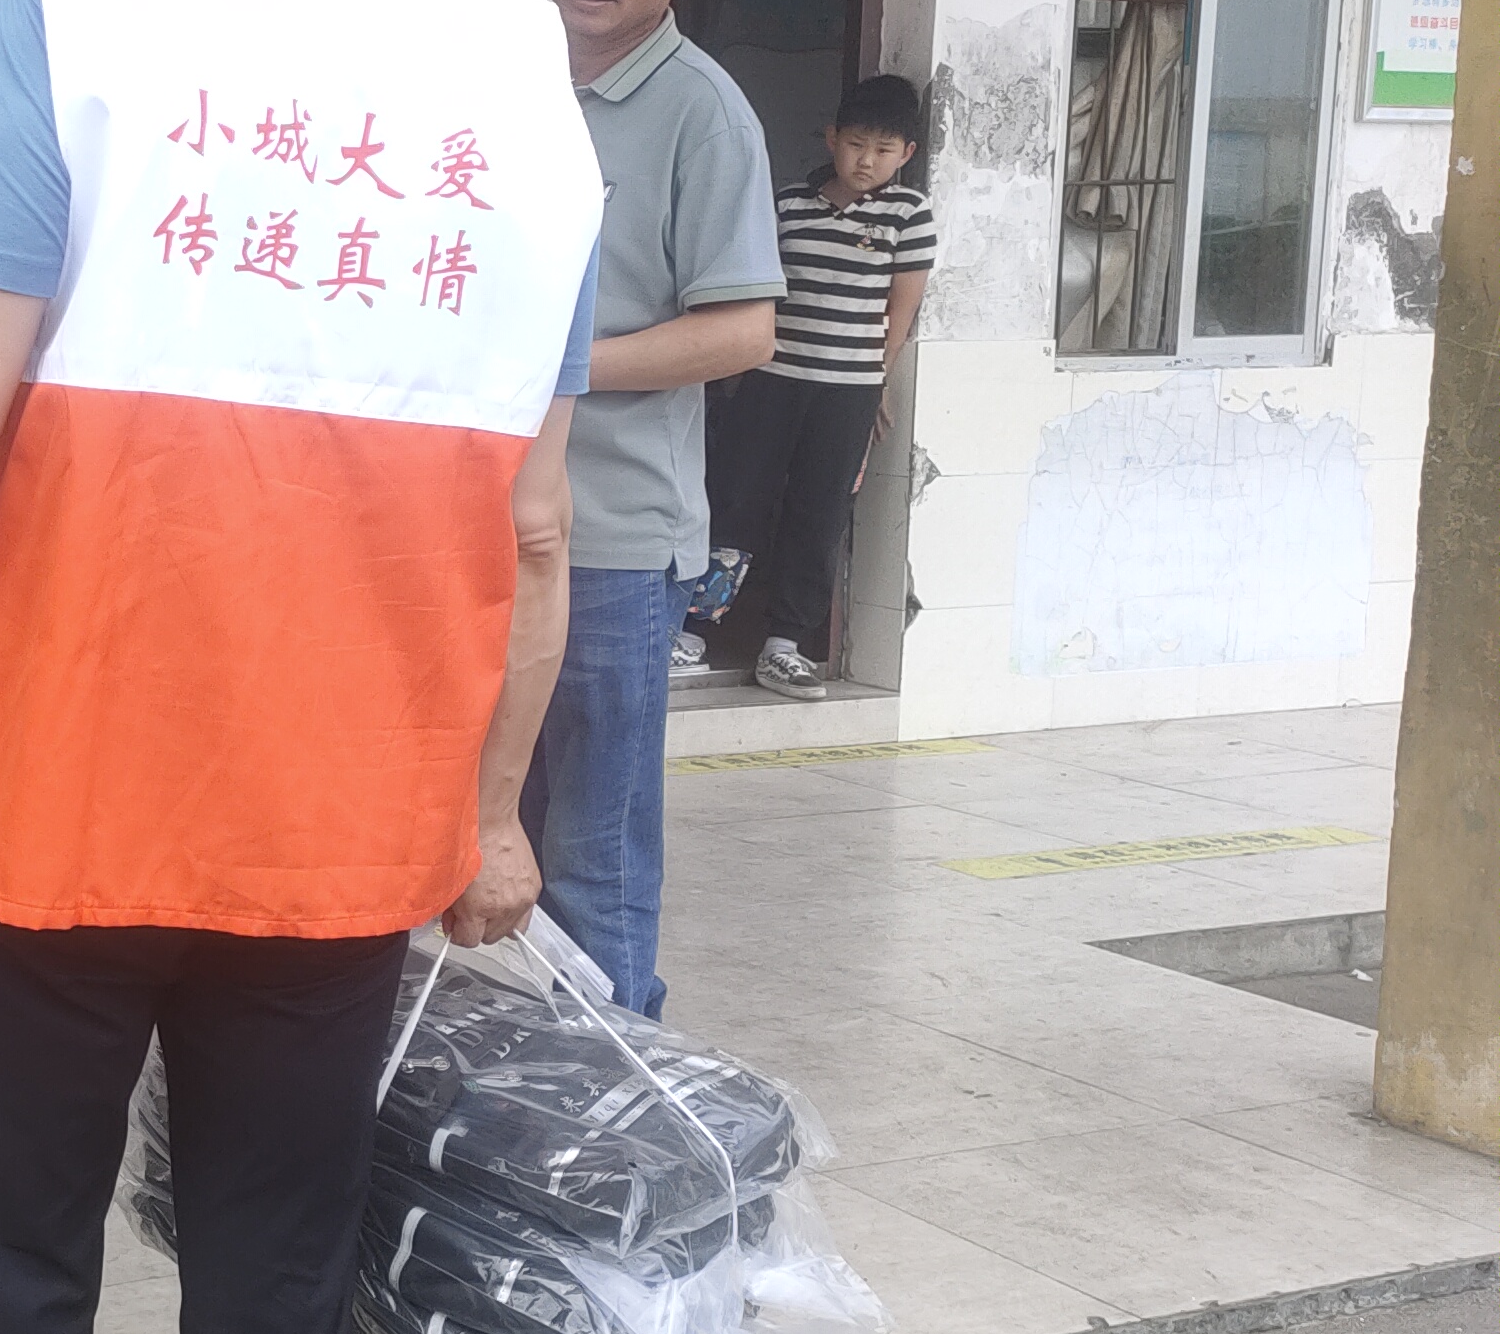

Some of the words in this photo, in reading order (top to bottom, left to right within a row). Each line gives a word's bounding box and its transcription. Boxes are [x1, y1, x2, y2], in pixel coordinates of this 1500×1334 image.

[167, 89, 494, 211] 小城大爱
[153, 192, 478, 317] 传递真情
